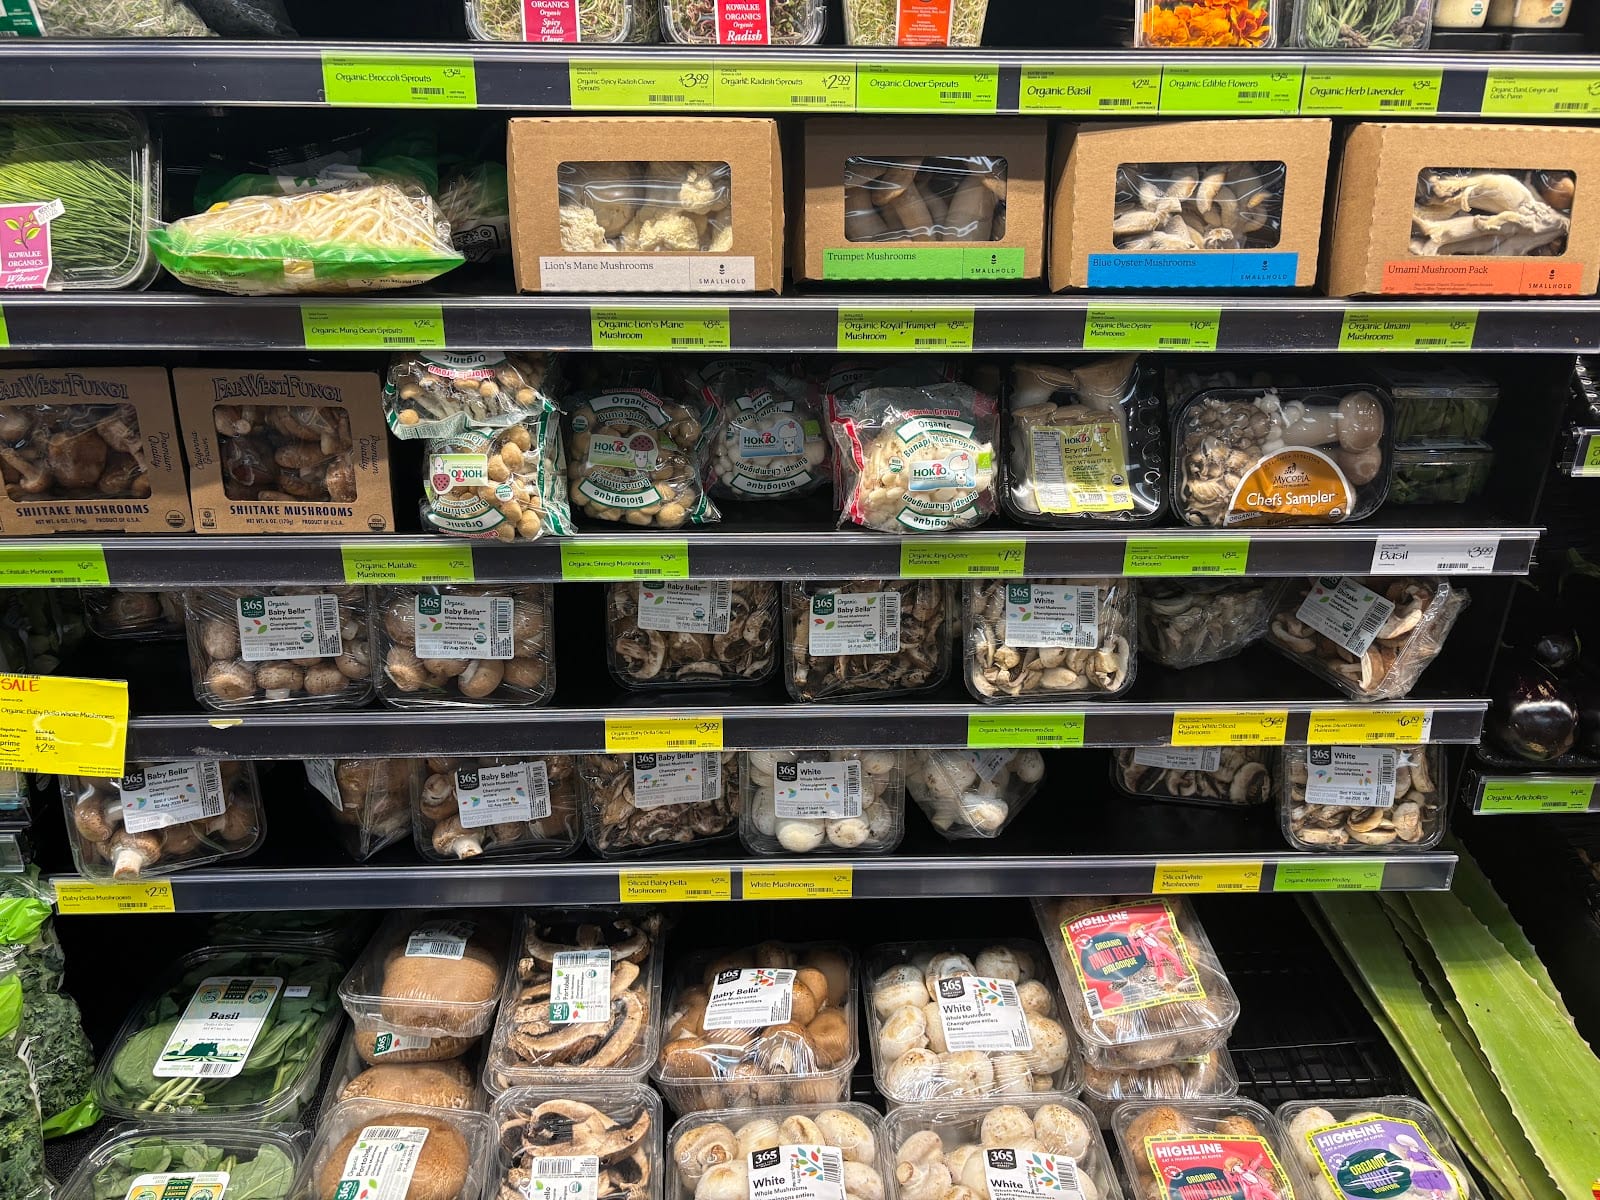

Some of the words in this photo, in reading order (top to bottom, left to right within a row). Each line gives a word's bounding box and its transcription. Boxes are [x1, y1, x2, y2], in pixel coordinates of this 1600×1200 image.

[531, 1, 569, 9] ORGANICS
[725, 3, 760, 11] KOWALKE
[542, 18, 561, 27] Spicy
[540, 27, 565, 35] Radish
[727, 30, 763, 41] Radish
[335, 72, 367, 83] Organic
[368, 72, 400, 82] Broccoli
[401, 72, 432, 83] Sprouts
[577, 78, 600, 87] Organic
[721, 77, 750, 88] Organic
[751, 77, 775, 86] Radish
[776, 77, 803, 87] Sprouts
[869, 78, 901, 90] Organic
[902, 78, 930, 88] Clover
[930, 79, 960, 90] Sprouts
[1169, 79, 1200, 91] Organic
[1202, 78, 1226, 88] Edible
[1227, 79, 1258, 88] Flowers
[1026, 85, 1066, 98] Organic
[1067, 85, 1092, 97] Basil
[1309, 86, 1344, 98] Organic
[1345, 86, 1366, 96] Herb
[1367, 86, 1406, 97] Lavender
[1490, 86, 1512, 95] Organic
[8, 251, 42, 259] KOWALKE
[827, 252, 864, 262] Trumpet
[866, 252, 917, 262] Mushrooms
[544, 261, 572, 270] Lion's
[573, 261, 597, 270] Mane
[600, 261, 654, 271] Mushrooms
[1092, 258, 1112, 267] Blue
[1113, 258, 1144, 269] Oyster
[1145, 258, 1196, 268] Mushrooms
[1387, 266, 1420, 275] Umami
[1421, 265, 1467, 275] Mushroom
[1467, 265, 1489, 275] Pack
[599, 320, 633, 330] Organic
[660, 320, 684, 329] Mane
[844, 320, 878, 331] Organic
[880, 320, 904, 331] Royal
[904, 320, 937, 331] Trumpet
[1090, 321, 1116, 331] Organic
[1131, 322, 1152, 331] Oyster
[1348, 321, 1382, 332] Organic
[1384, 321, 1411, 330] Umami
[311, 327, 338, 338] Organic
[339, 327, 358, 338] Mung
[600, 330, 643, 340] Mushroom
[845, 331, 887, 341] Mushroom
[1090, 329, 1126, 337] Mushrooms
[1346, 332, 1394, 341] Mushrooms
[443, 353, 486, 364] Organic
[611, 396, 650, 411] Organic
[934, 408, 960, 418] Grown
[918, 420, 952, 431] Organic
[903, 438, 931, 459] Bunapi
[932, 436, 977, 453] Mushroom
[746, 480, 796, 491] Biologique
[599, 489, 645, 505] Biologique
[1285, 491, 1336, 509] Sampler
[16, 505, 72, 517] SHIITAKE
[74, 504, 151, 517] MUSHROOMS
[229, 506, 281, 516] SHIITAKE
[283, 507, 353, 517] MUSHROOMS
[445, 519, 484, 530] Organic
[908, 552, 933, 560] Organic
[934, 552, 948, 561] King
[948, 552, 968, 560] Oyster
[1379, 550, 1409, 561] Basil
[355, 562, 387, 572] Organic
[667, 583, 684, 593] Baby
[1010, 588, 1029, 598] 365
[243, 600, 263, 611] 365
[267, 600, 289, 609] Organic
[420, 597, 440, 608] 365
[444, 599, 465, 608] Organic
[814, 599, 832, 609] 365
[837, 598, 857, 607] Organic
[1034, 597, 1055, 605] White
[268, 608, 286, 618] Baby
[444, 609, 462, 618] Baby
[837, 607, 854, 616] Baby
[0, 678, 40, 692] SALE
[1, 707, 27, 715] Organic
[26, 709, 43, 718] Baby
[1177, 723, 1201, 731] Organic
[636, 754, 655, 765] 365
[658, 754, 676, 764] Baby
[1311, 749, 1329, 760] 365
[1334, 752, 1356, 761] White
[147, 770, 167, 782] Baby
[778, 765, 796, 777] 365
[800, 768, 822, 777] White
[123, 773, 144, 786] 365
[459, 772, 477, 784] 365
[481, 772, 499, 782] Baby
[1486, 793, 1515, 804] Organic
[1514, 793, 1549, 802] Artichokes
[1162, 874, 1184, 882] Sliced
[1184, 874, 1203, 882] White
[627, 879, 650, 888] Sliced
[650, 879, 669, 889] Baby
[669, 879, 687, 888] Bella
[750, 881, 771, 889] White
[772, 881, 815, 889] Mushrooms
[1161, 881, 1200, 889] Mushrooms
[628, 887, 667, 896] Mushrooms
[62, 895, 79, 903] Baby
[79, 894, 95, 902] Bella
[95, 894, 132, 902] Mushrooms
[1069, 910, 1129, 933] HIGHLINE
[1094, 938, 1122, 952] ORGANIC
[1087, 949, 1114, 971] MINI
[1101, 957, 1138, 977] BIOLOGIQUE
[941, 979, 962, 994] 365
[712, 991, 736, 1003] Baby
[552, 1003, 563, 1020] 365
[942, 1003, 972, 1014] White
[208, 1011, 241, 1020] Basil
[945, 1014, 962, 1023] Whole
[946, 1019, 981, 1029] Champignons
[377, 1035, 388, 1052] 365
[1155, 1143, 1225, 1158] HIGHLINE
[356, 1145, 374, 1177] Portobello
[755, 1150, 778, 1165] 365
[990, 1149, 1014, 1164] 365
[1348, 1154, 1389, 1176] ORGANIC
[752, 1176, 786, 1190] White
[1185, 1172, 1217, 1184] ORGANIC
[989, 1178, 1023, 1190] White
[337, 1180, 354, 1200] 365
[754, 1189, 773, 1198] Whole
[773, 1186, 808, 1195] Mushrooms
[795, 1192, 815, 1200] entiers
